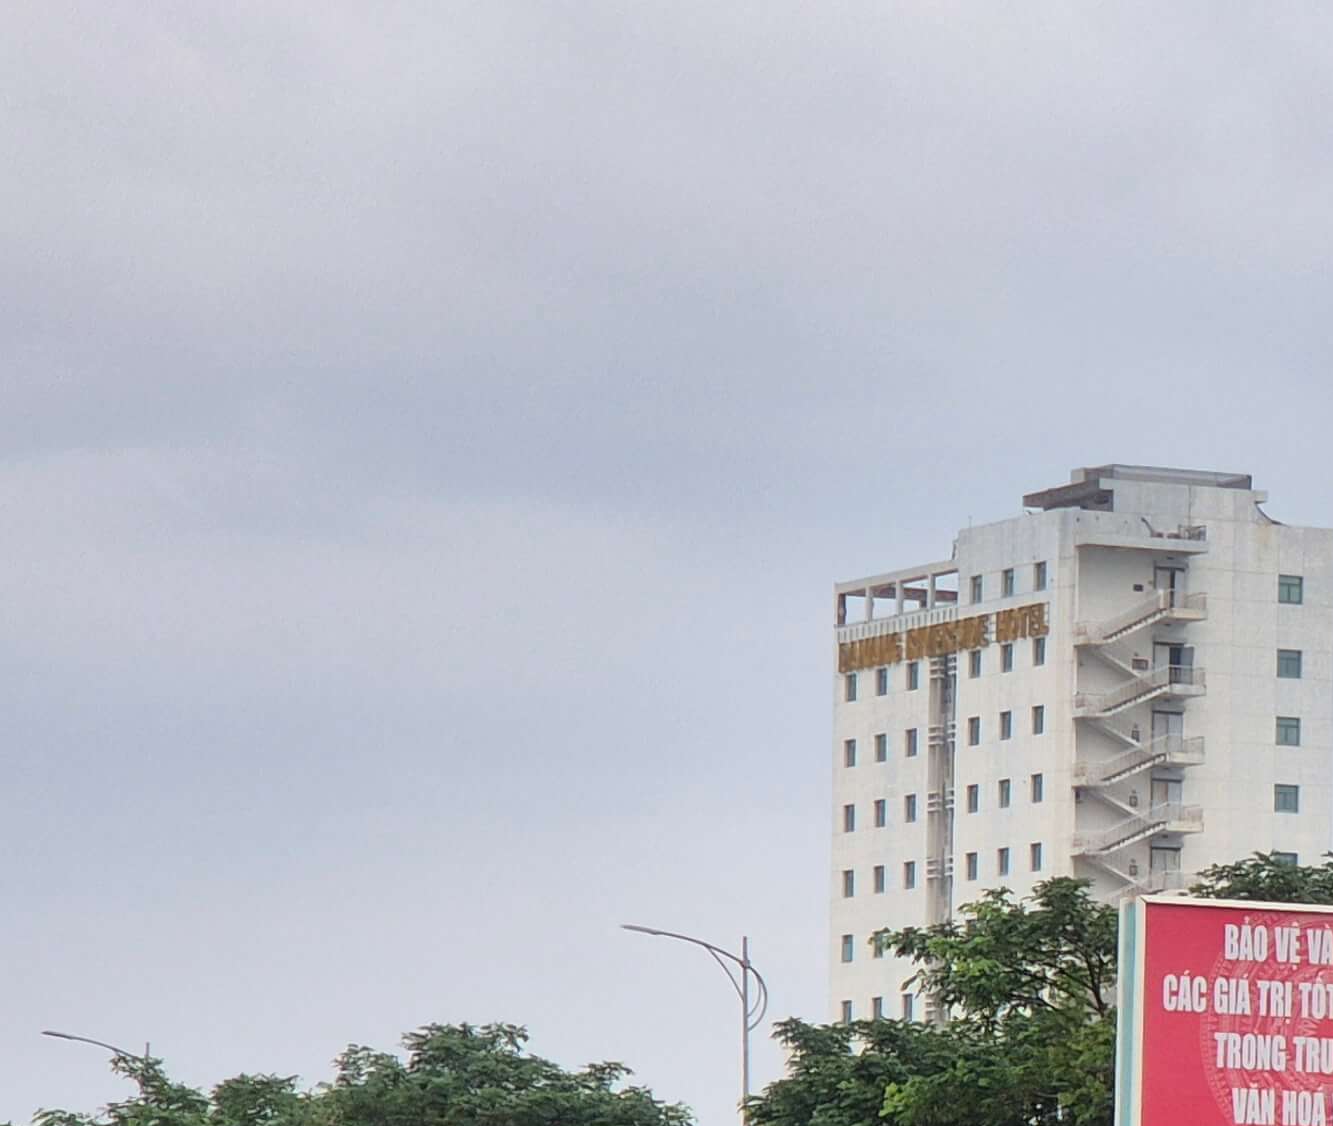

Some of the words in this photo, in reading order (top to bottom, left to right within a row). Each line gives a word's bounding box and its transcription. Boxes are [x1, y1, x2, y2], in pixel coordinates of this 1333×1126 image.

[1224, 916, 1268, 962] BẢO
[1275, 921, 1301, 970] VỆ
[1162, 970, 1208, 1014] CÁC
[1214, 973, 1251, 1016] GIÁ
[1257, 979, 1293, 1024] TRỊ
[1214, 1032, 1287, 1072] TRONG
[1231, 1082, 1276, 1126] VĂN
